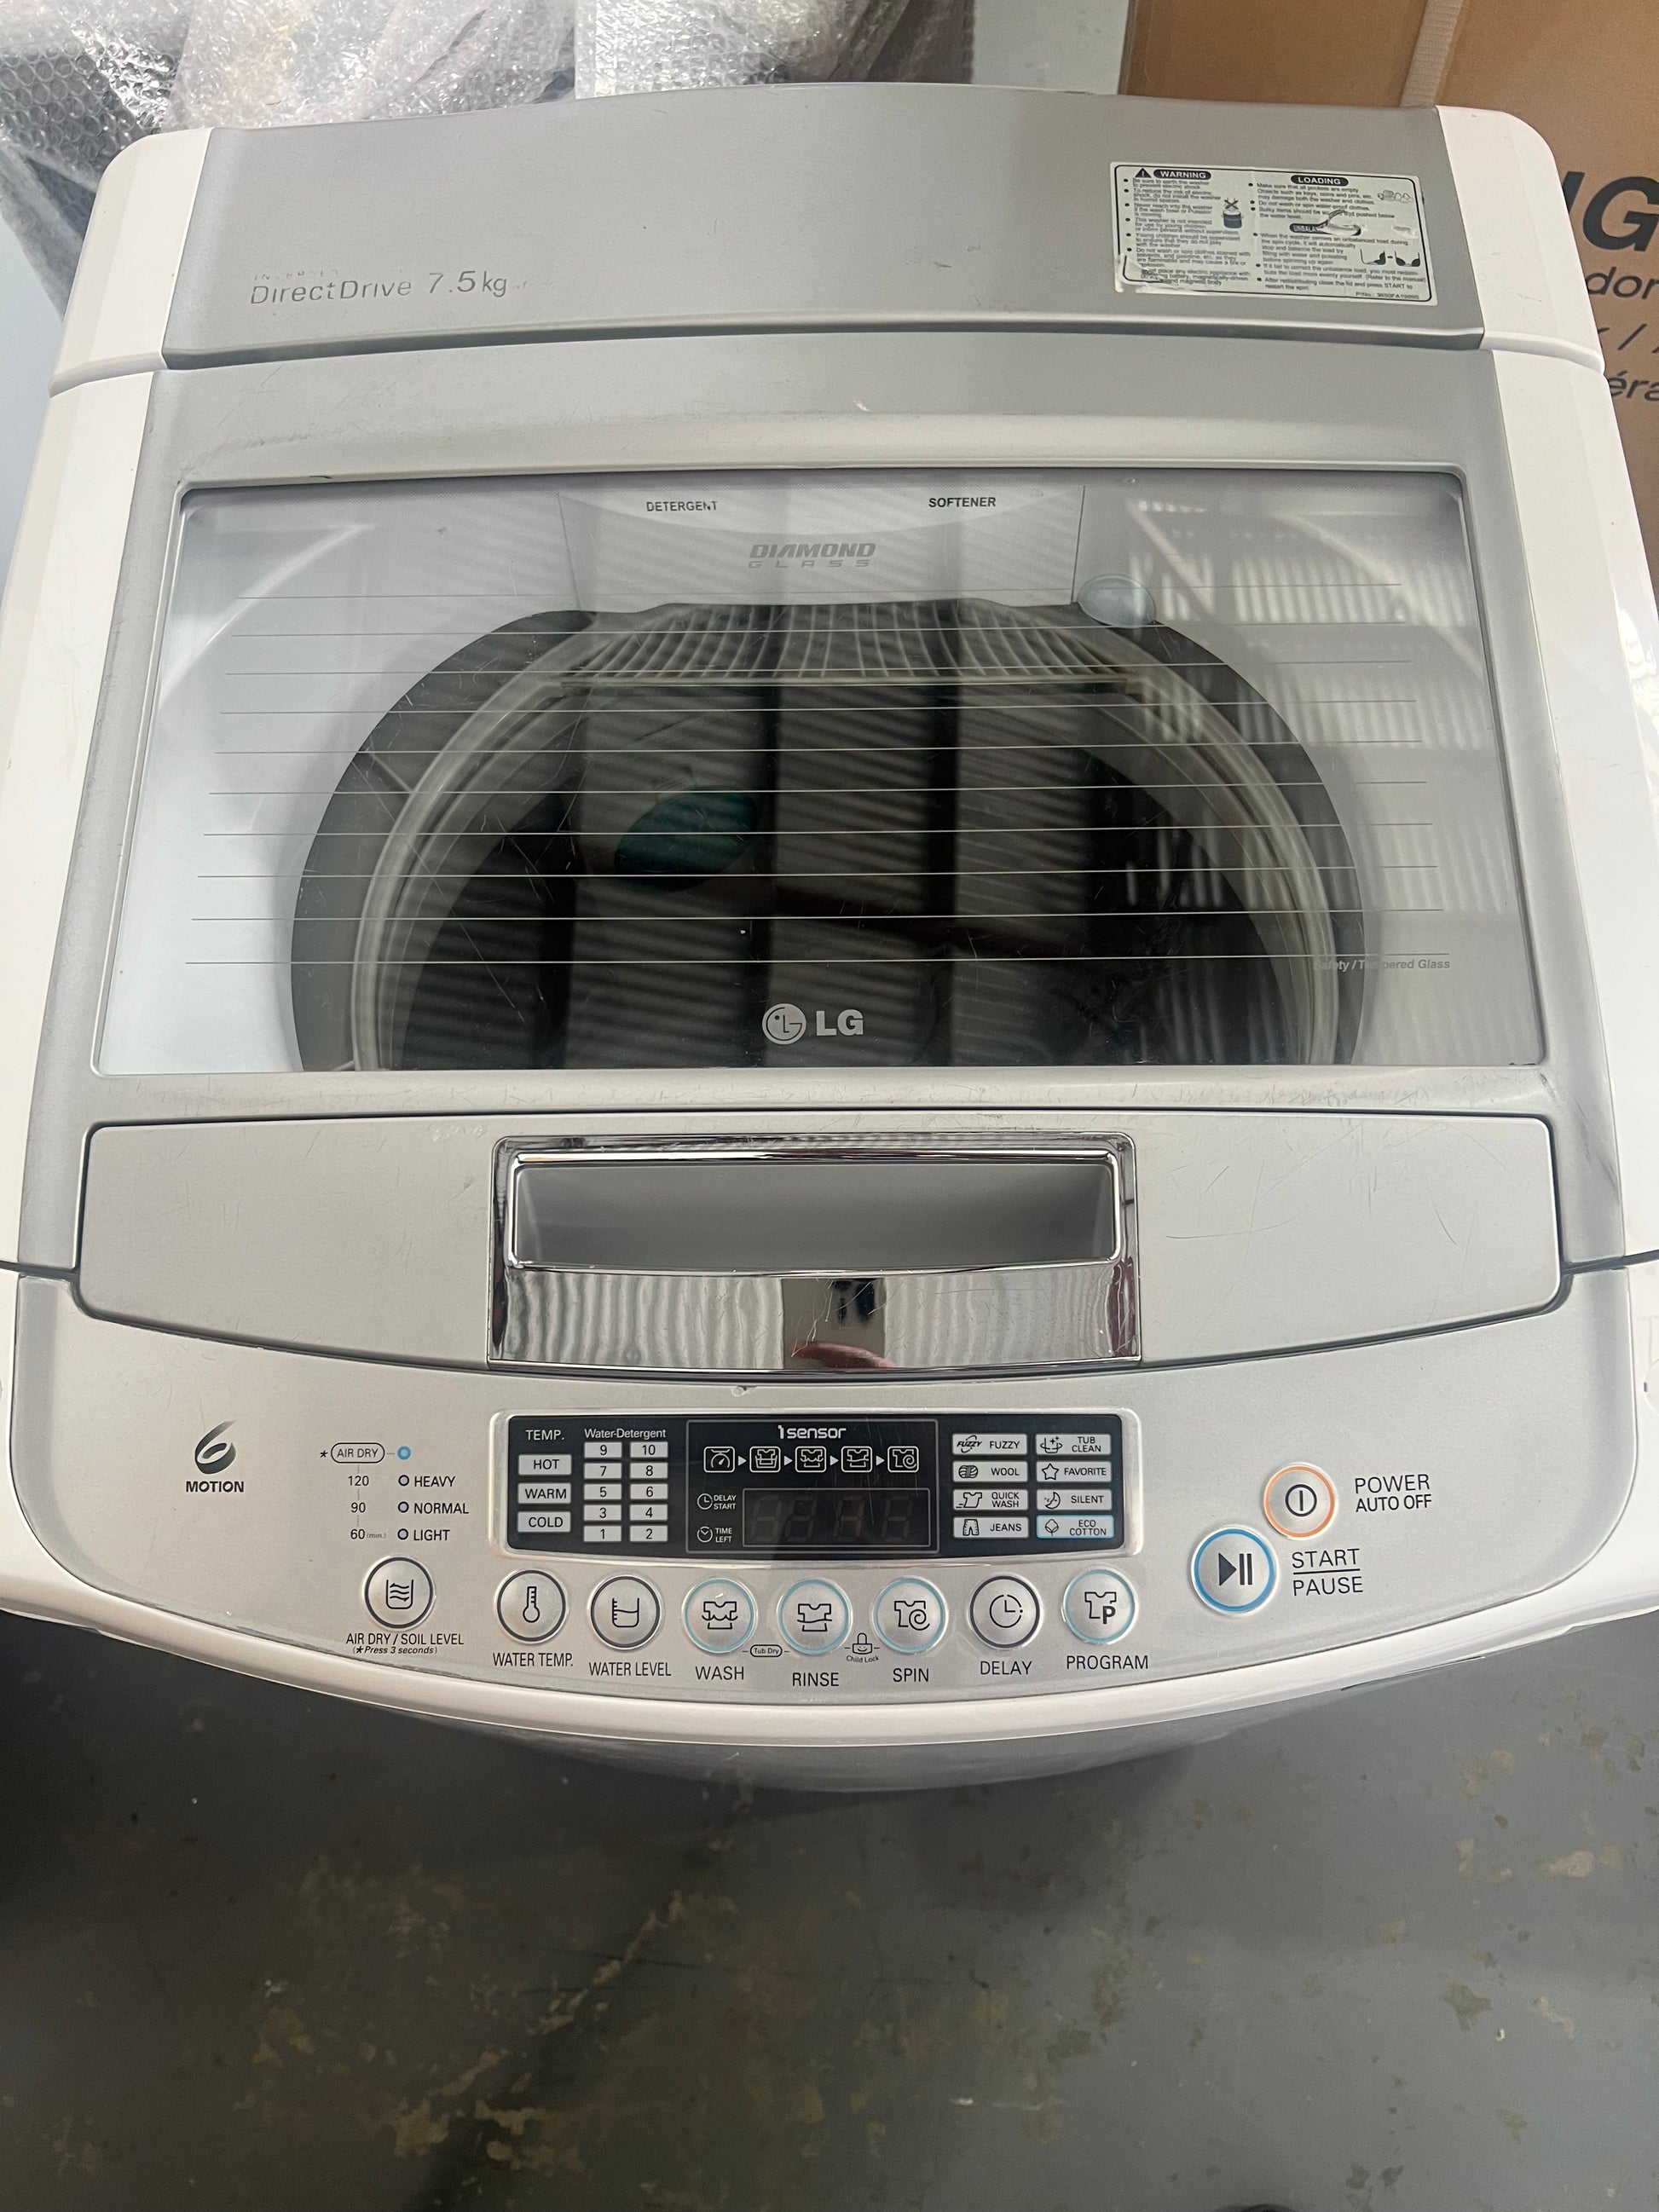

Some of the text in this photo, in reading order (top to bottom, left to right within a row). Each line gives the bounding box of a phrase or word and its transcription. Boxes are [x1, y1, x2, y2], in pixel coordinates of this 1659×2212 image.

[1160, 170, 1206, 179] WARNING
[1298, 176, 1341, 185] LOADING
[646, 500, 718, 511] DETERGENT
[928, 497, 997, 509] SOFTENER
[749, 543, 876, 558] DIAMOND
[749, 559, 870, 569] GLASS
[1358, 960, 1414, 970] Tpered
[1418, 959, 1451, 969] Glass
[816, 1008, 864, 1037] LG
[525, 1429, 565, 1441] TEMP.
[584, 1428, 667, 1440] Water-Detergent
[599, 1444, 608, 1456] 9
[641, 1444, 656, 1456] 10
[989, 1441, 1020, 1449] FUZZY
[1072, 1444, 1101, 1453] CLEAN
[337, 1448, 379, 1458] AIR DRY
[533, 1458, 560, 1470] HOT
[645, 1464, 654, 1476] 8
[599, 1465, 607, 1476] 7
[991, 1467, 1020, 1476] WOOL
[1064, 1467, 1107, 1476] FAVORITE
[185, 1481, 245, 1493] MOTION
[347, 1476, 370, 1487] 120
[413, 1476, 456, 1487] HEAVY
[1355, 1474, 1430, 1494] POWER
[524, 1488, 567, 1499] WARM
[599, 1486, 607, 1498] 5
[645, 1486, 654, 1498] 6
[991, 1492, 1020, 1500] QUICK
[1071, 1495, 1105, 1504] SILENT
[1355, 1493, 1432, 1513] AUTO OFF
[350, 1502, 367, 1514] 90
[413, 1502, 470, 1515] NORMAL
[599, 1507, 607, 1518] 3
[645, 1507, 654, 1518] 4
[528, 1516, 564, 1528] COLD
[990, 1523, 1022, 1532] JEANS
[350, 1529, 366, 1539] 60
[413, 1529, 450, 1541] LIGHT
[645, 1528, 653, 1539] 2
[1069, 1528, 1107, 1536] COTTON
[1292, 1548, 1361, 1568] START
[1292, 1576, 1364, 1597] PAUSE
[345, 1633, 365, 1645] AIR
[367, 1633, 391, 1645] DRY
[401, 1633, 427, 1646] SOIL
[431, 1633, 465, 1646] LEVEL
[390, 1646, 396, 1655] 3
[398, 1646, 438, 1655] seconds)
[767, 1647, 779, 1656] Dry
[492, 1653, 574, 1667] WATER TEMP.
[846, 1655, 880, 1663] Child Lock
[1066, 1655, 1149, 1671] PROGRAM
[589, 1661, 672, 1677] WATER LEVEL
[695, 1666, 744, 1681] WASH
[980, 1660, 1032, 1676] DELAY
[792, 1672, 840, 1688] RINSE
[893, 1668, 930, 1683] SPIN
